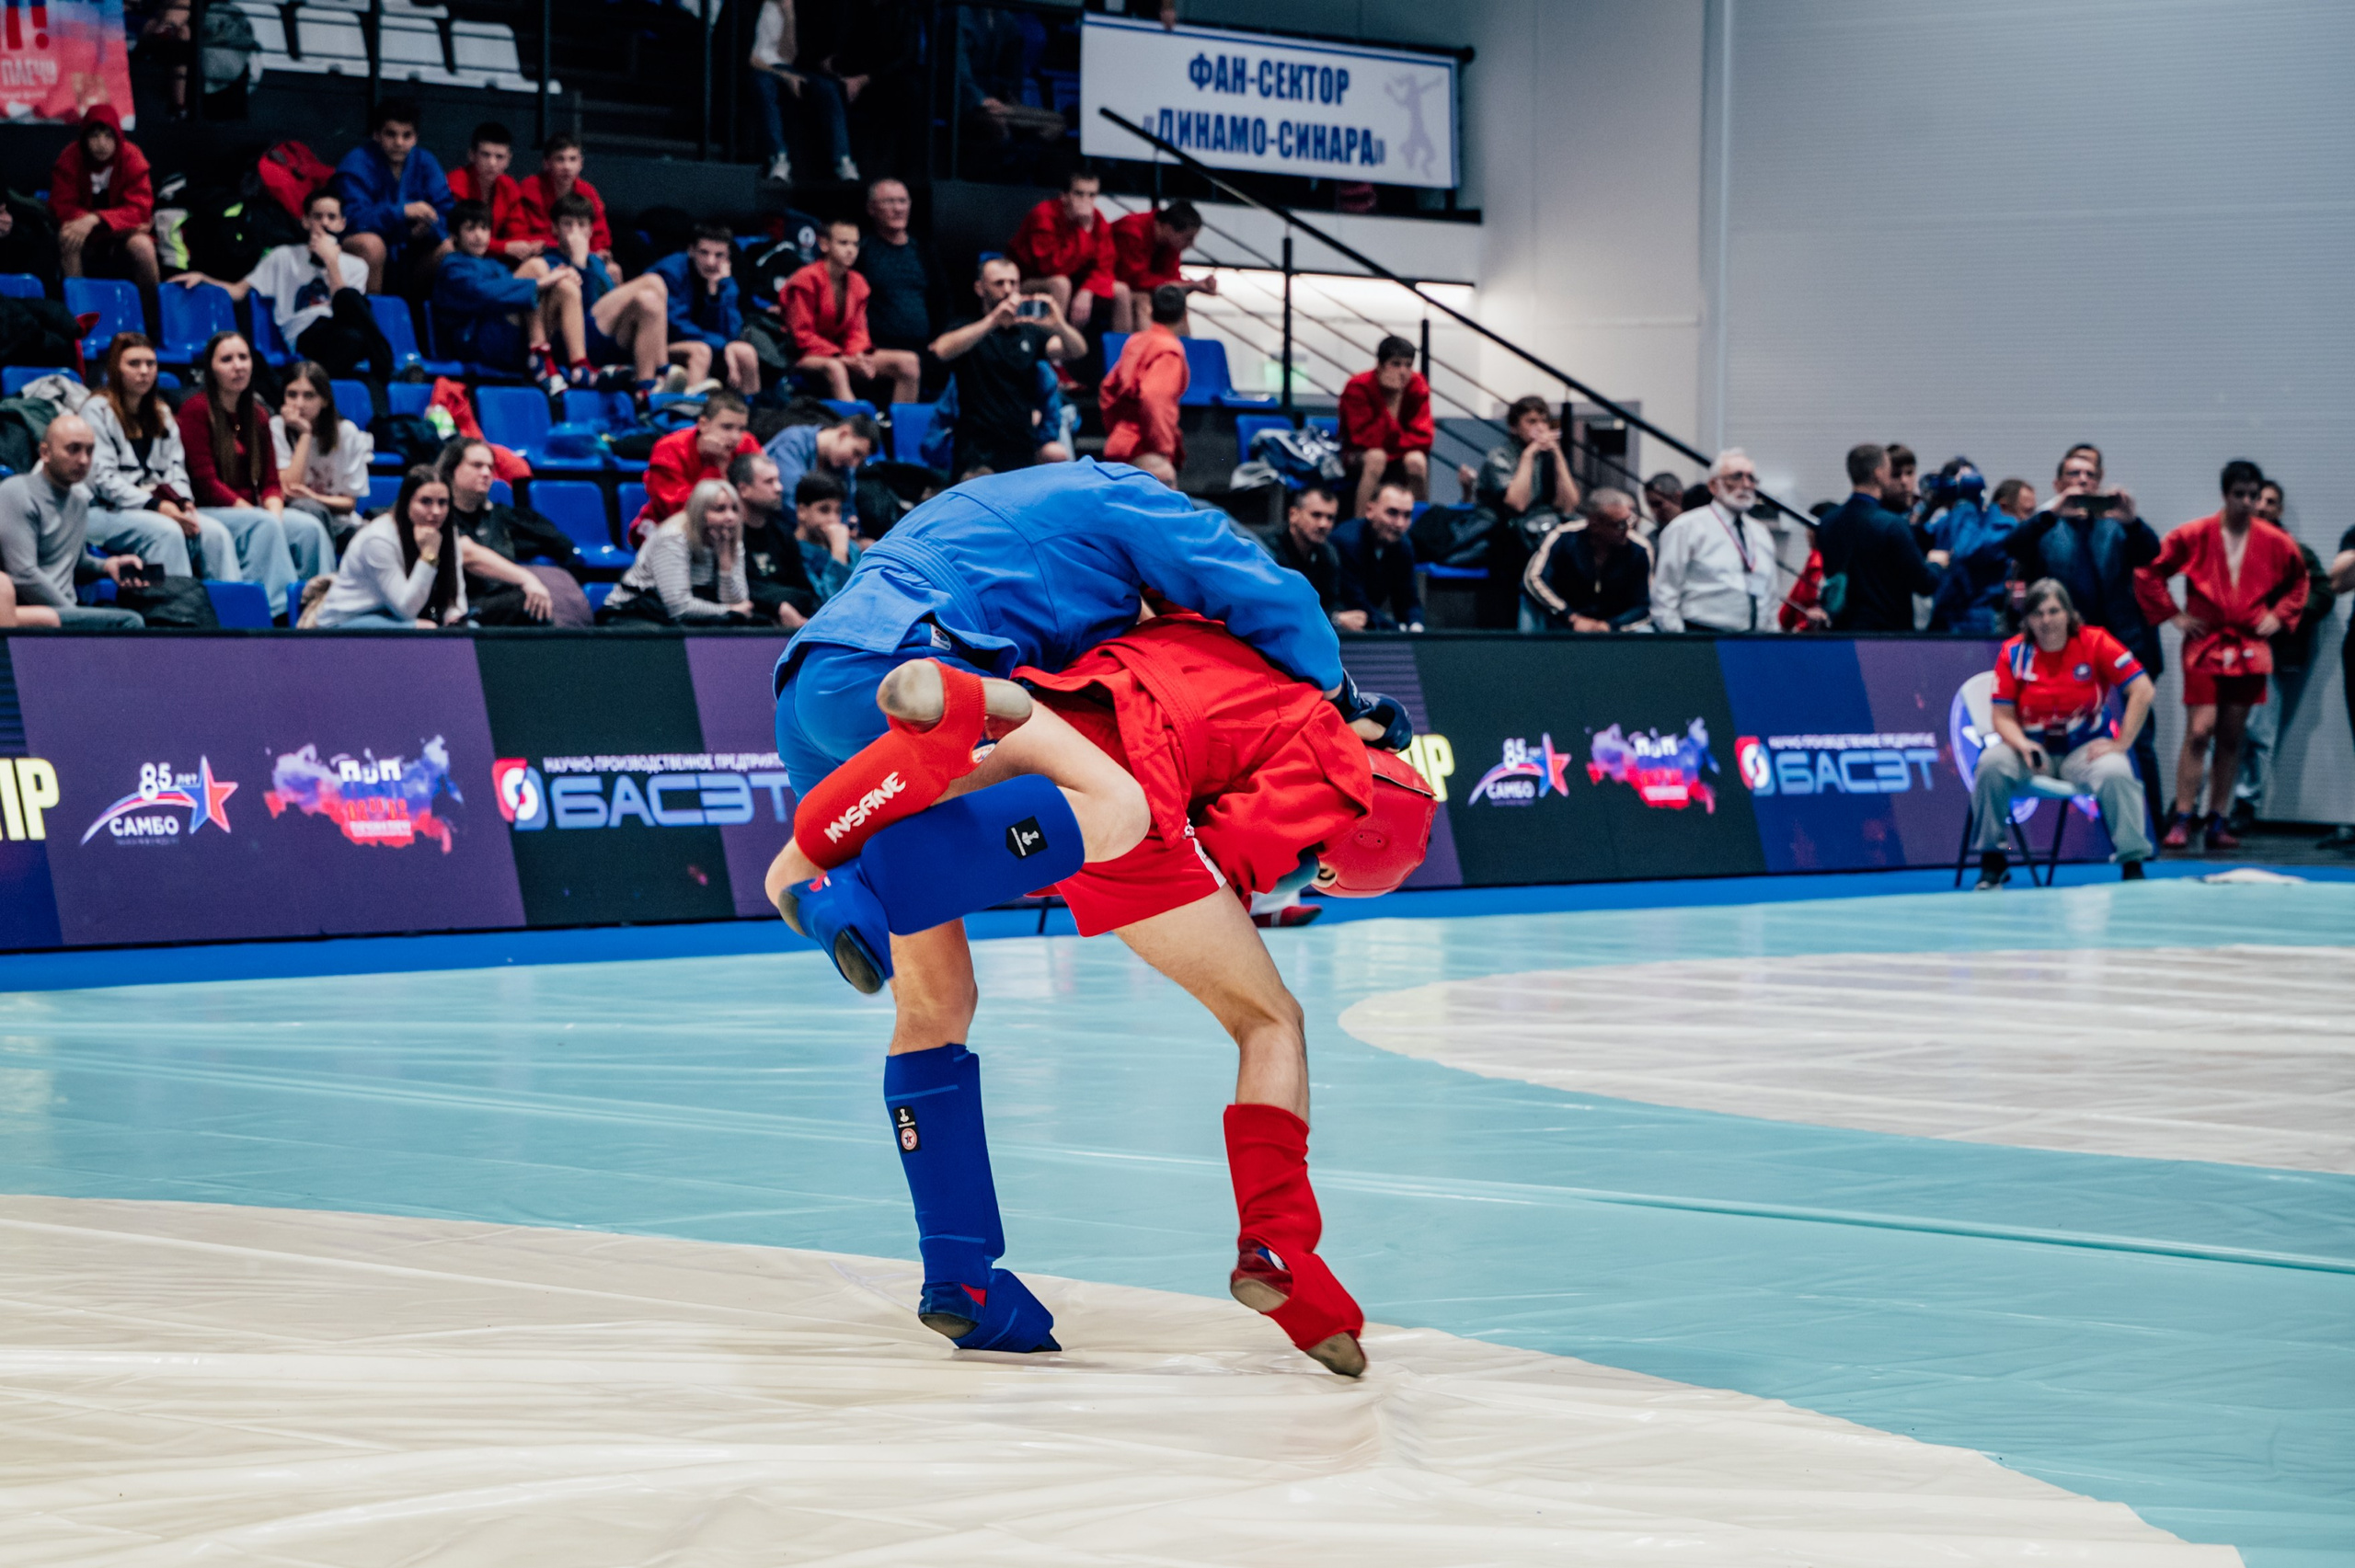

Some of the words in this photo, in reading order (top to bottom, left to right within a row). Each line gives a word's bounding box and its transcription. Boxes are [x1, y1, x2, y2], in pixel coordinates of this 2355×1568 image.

[1188, 52, 1350, 106] ФАН-СЕКТОР
[139, 761, 173, 801] 85
[1775, 748, 1939, 795] БАСЭТ
[550, 772, 792, 829] БАСЭТ
[823, 771, 906, 844] INSANE
[109, 815, 180, 837] САМБО
